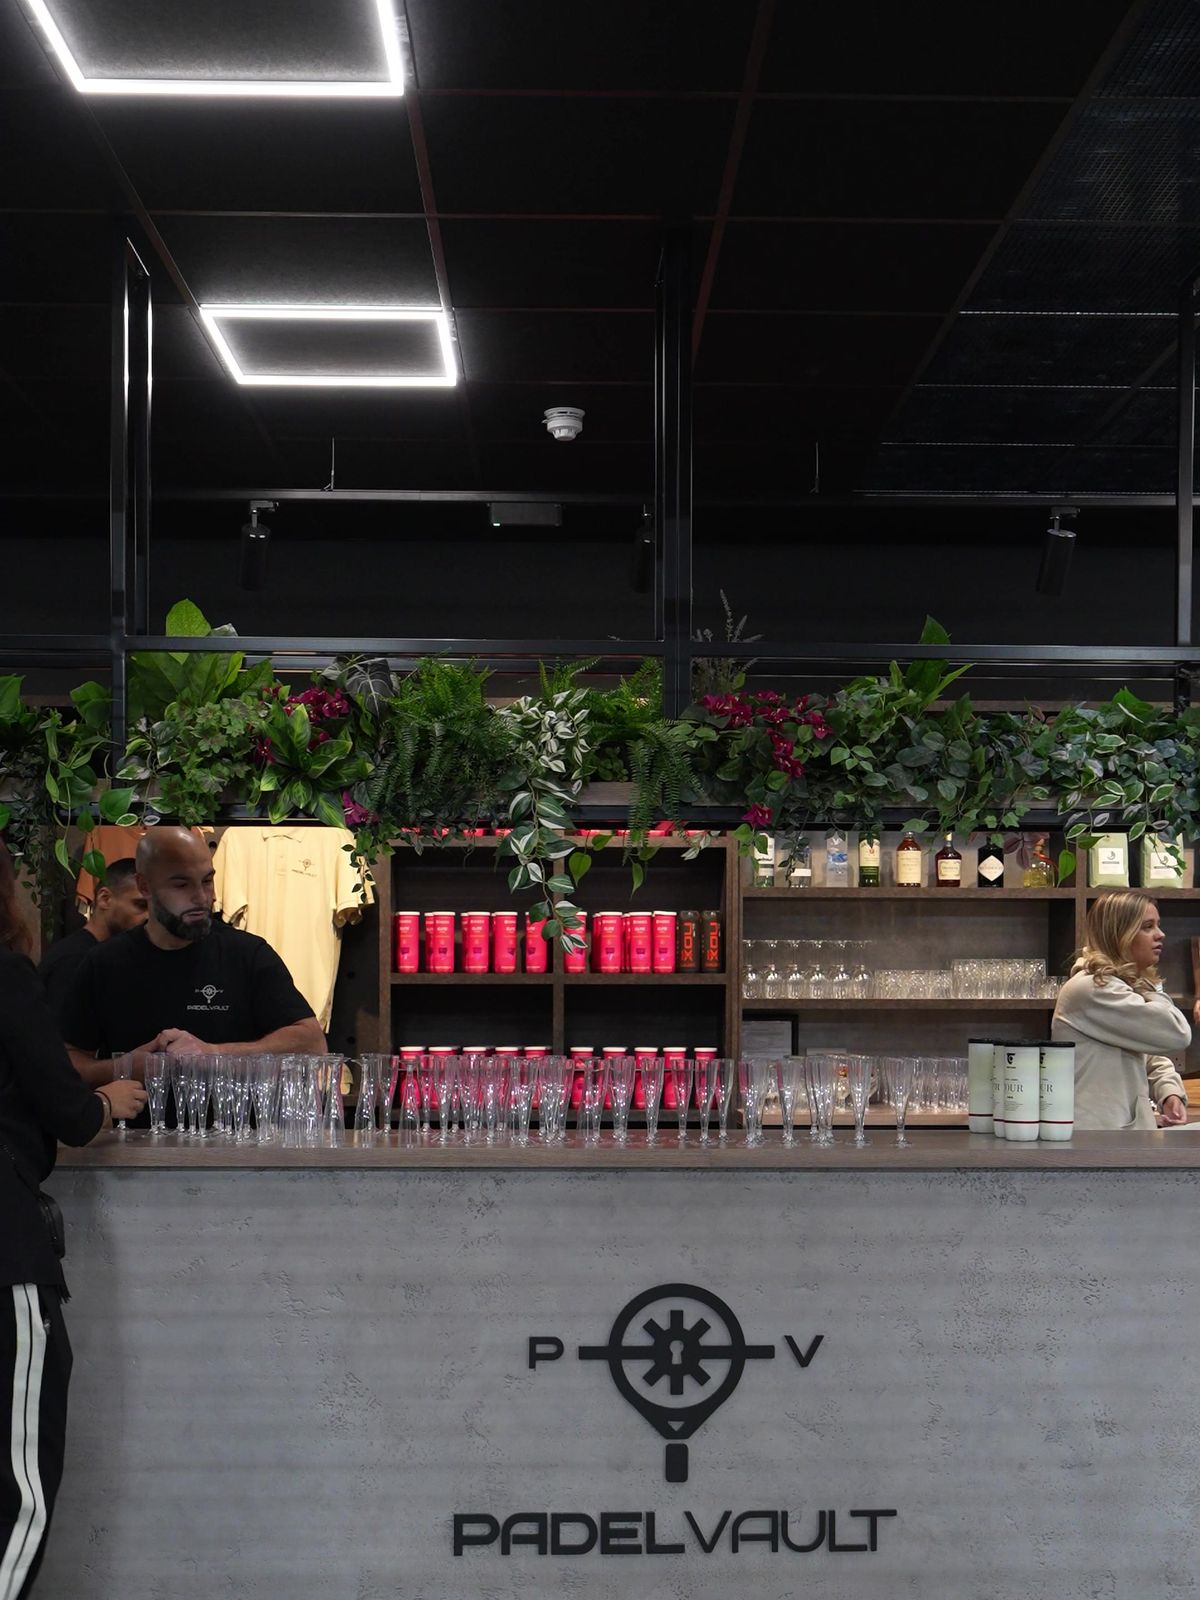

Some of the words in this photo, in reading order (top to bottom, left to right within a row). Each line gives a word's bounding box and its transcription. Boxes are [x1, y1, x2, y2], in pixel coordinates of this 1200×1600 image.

[528, 1335, 565, 1369] P
[784, 1334, 825, 1368] V
[453, 1508, 898, 1556] PADELVAULT
